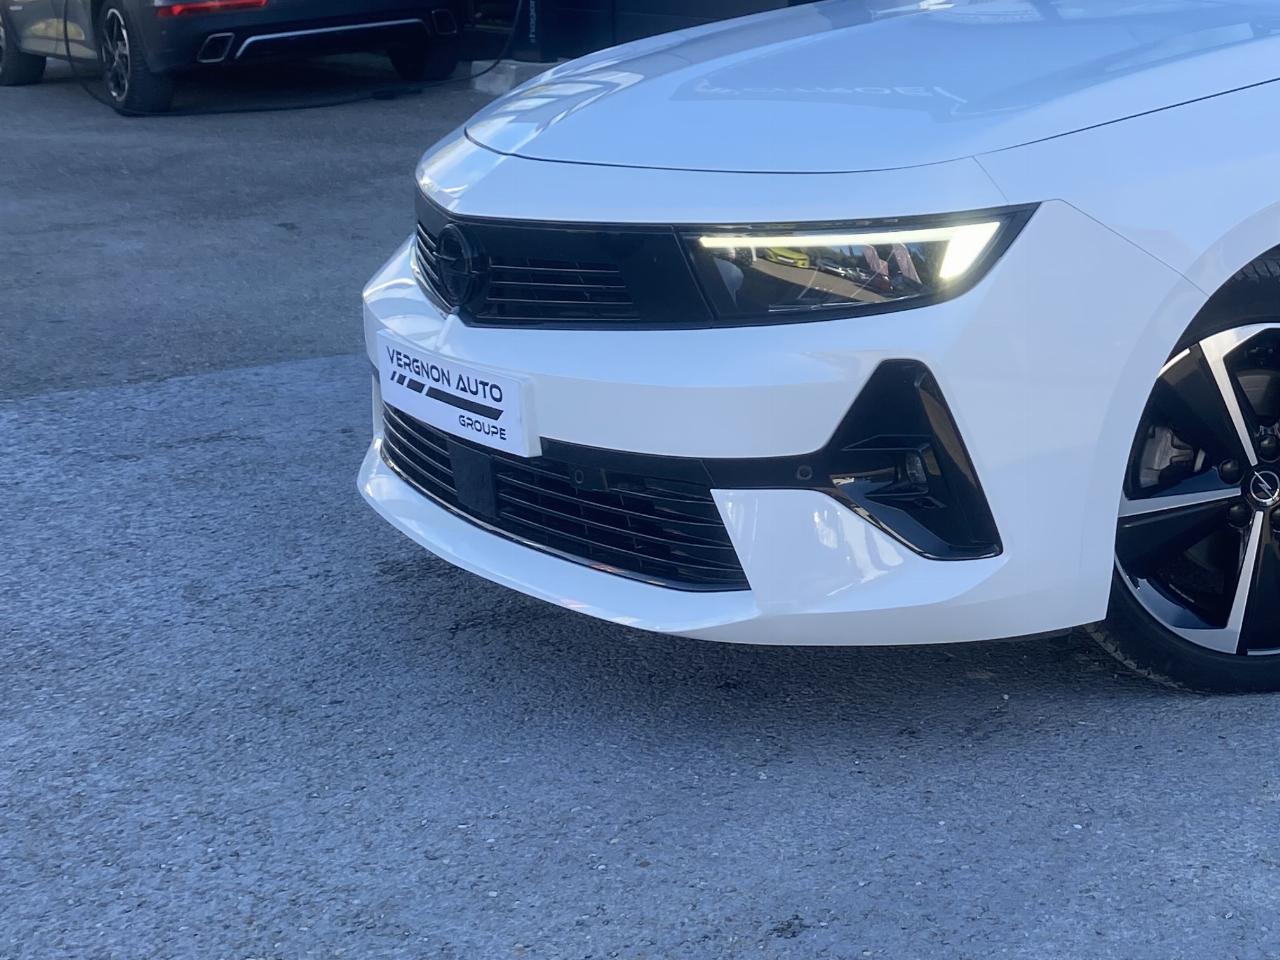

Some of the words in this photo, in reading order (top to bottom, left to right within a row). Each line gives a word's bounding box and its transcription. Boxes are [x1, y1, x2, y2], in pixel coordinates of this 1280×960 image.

[386, 345, 451, 388] VERGNON
[455, 374, 503, 403] AUTO
[458, 415, 507, 440] GROUPE
